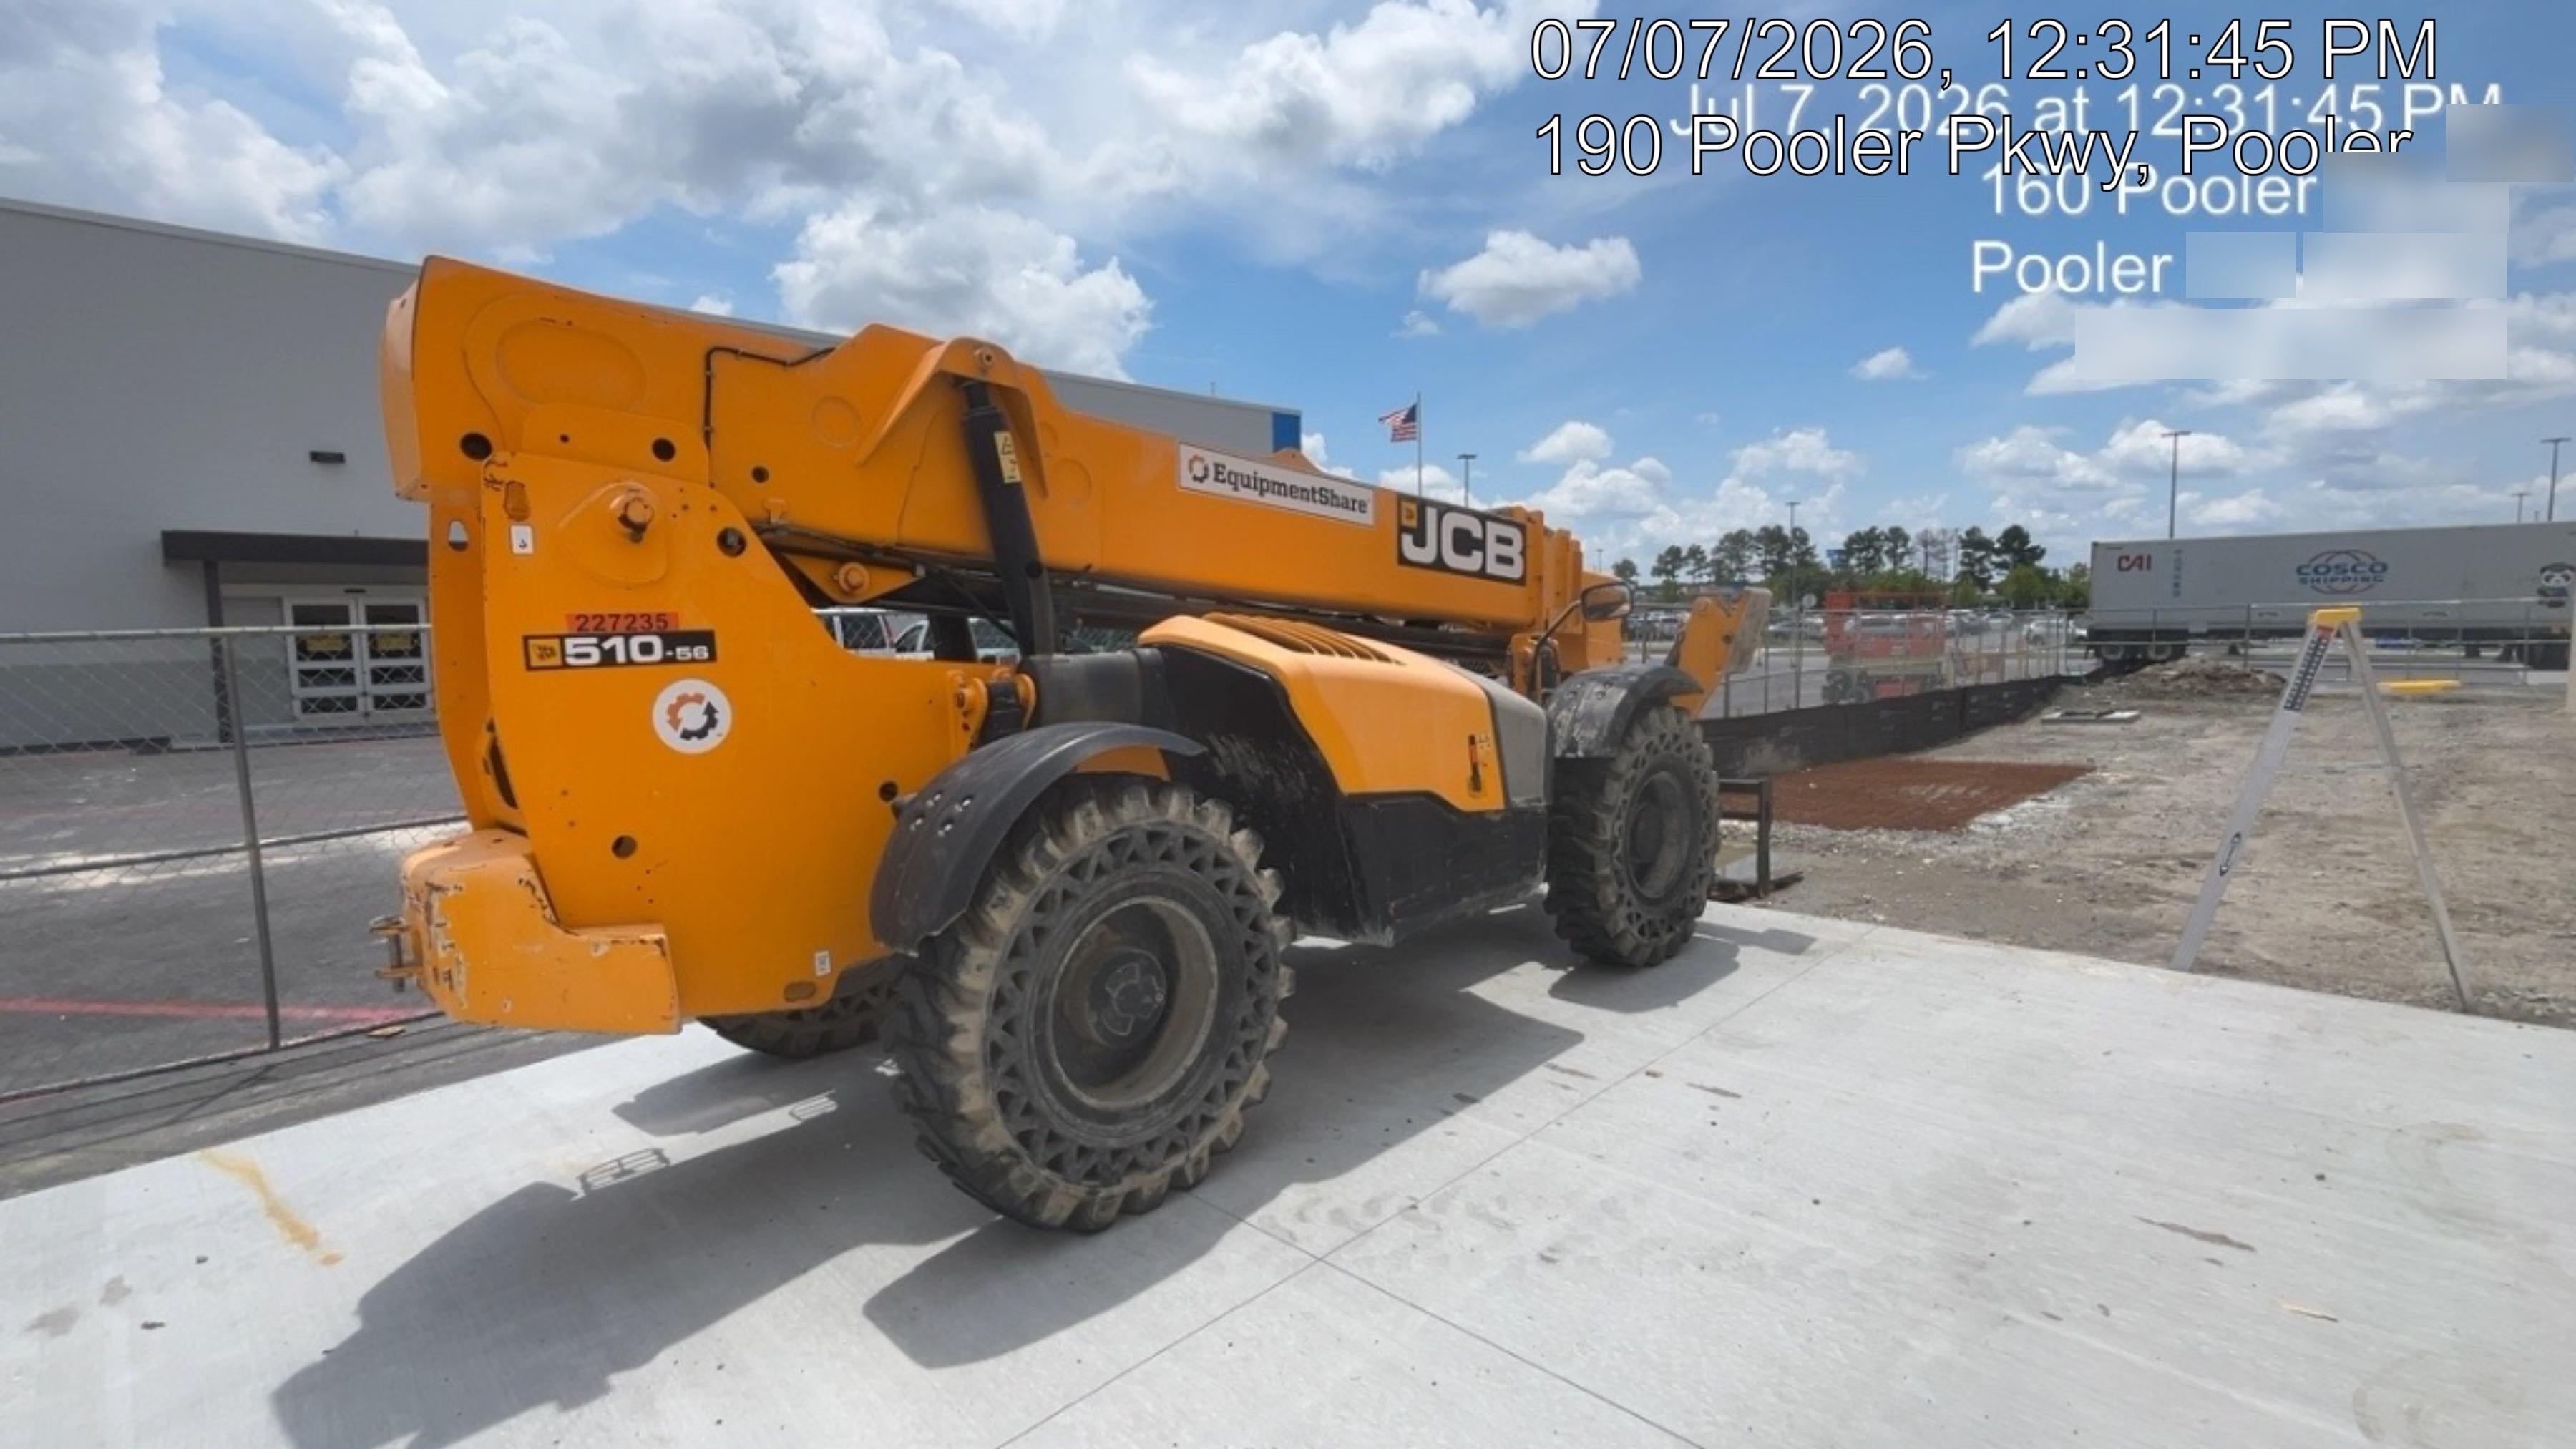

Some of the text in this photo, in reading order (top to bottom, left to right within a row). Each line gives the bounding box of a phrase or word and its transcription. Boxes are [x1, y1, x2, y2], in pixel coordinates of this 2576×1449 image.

[1212, 462, 1368, 514] EquipmentShare
[1400, 505, 1523, 579] JCB
[2117, 554, 2152, 572] CAI
[2296, 562, 2388, 576] COSCO
[575, 613, 668, 633] 227235
